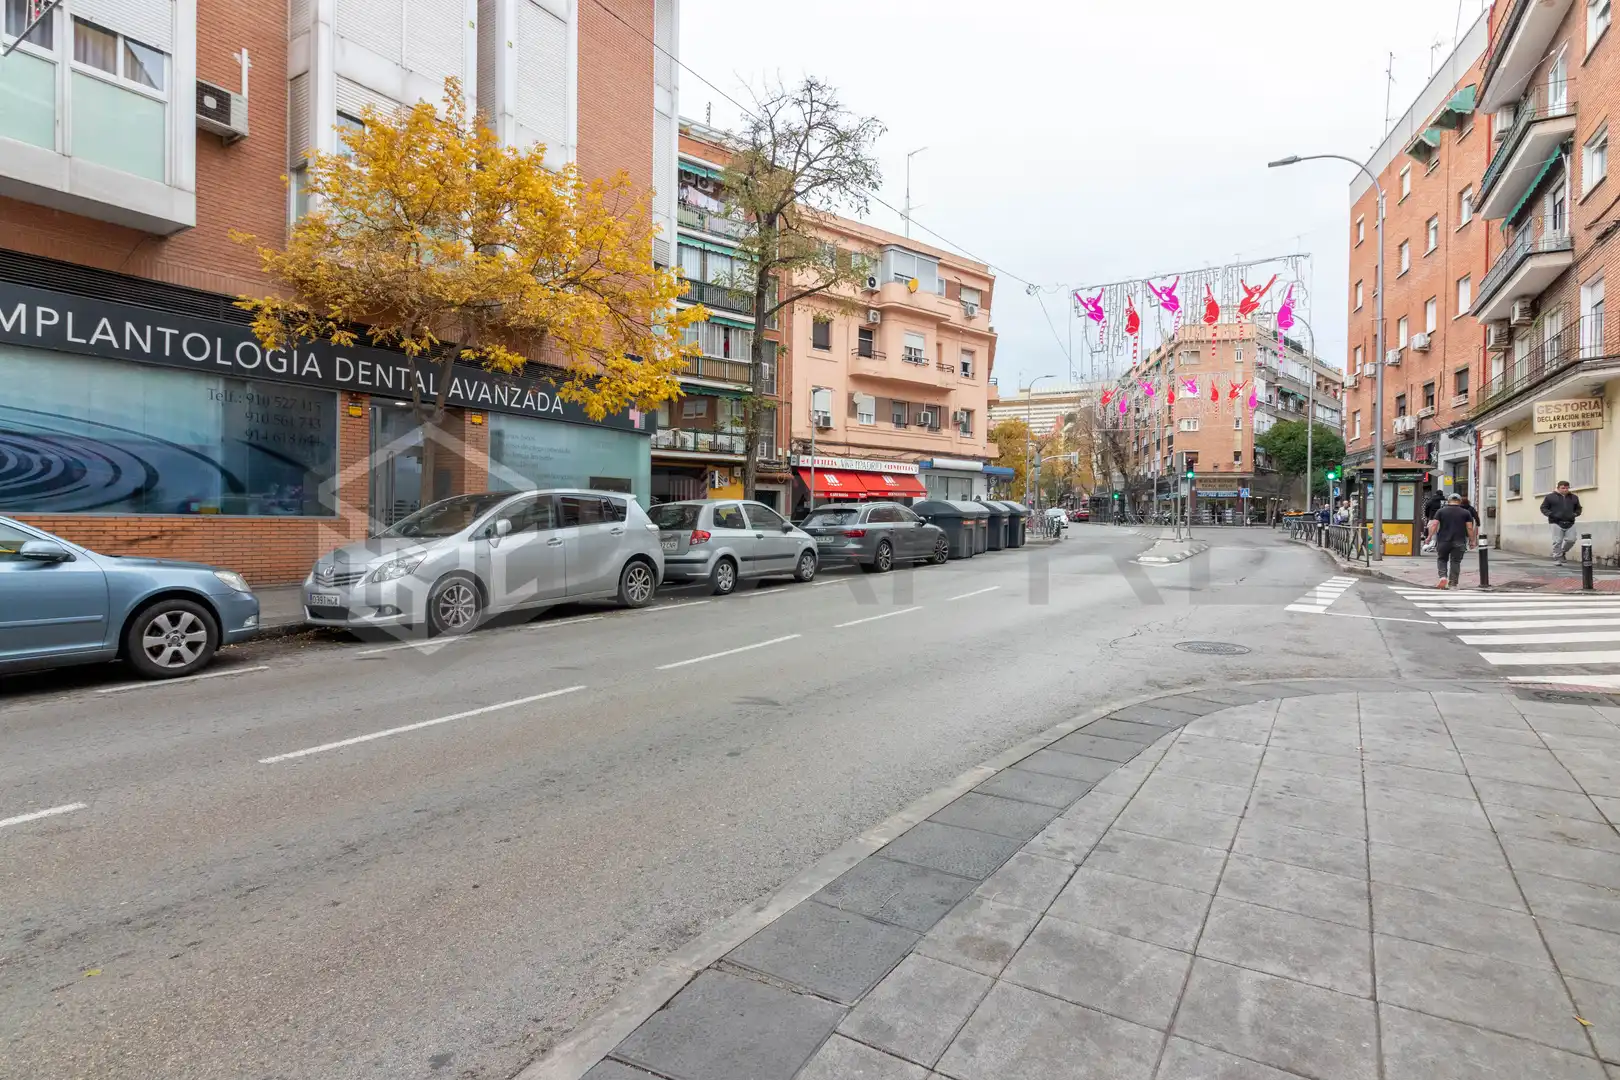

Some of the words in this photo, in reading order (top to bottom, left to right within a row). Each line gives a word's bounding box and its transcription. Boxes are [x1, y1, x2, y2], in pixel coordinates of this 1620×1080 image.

[335, 356, 439, 396] DENTAL
[447, 377, 565, 416] AVANZADA
[1536, 400, 1601, 415] GESTORIA
[1581, 411, 1602, 419] RENTA
[1548, 420, 1591, 430] APERTURAS
